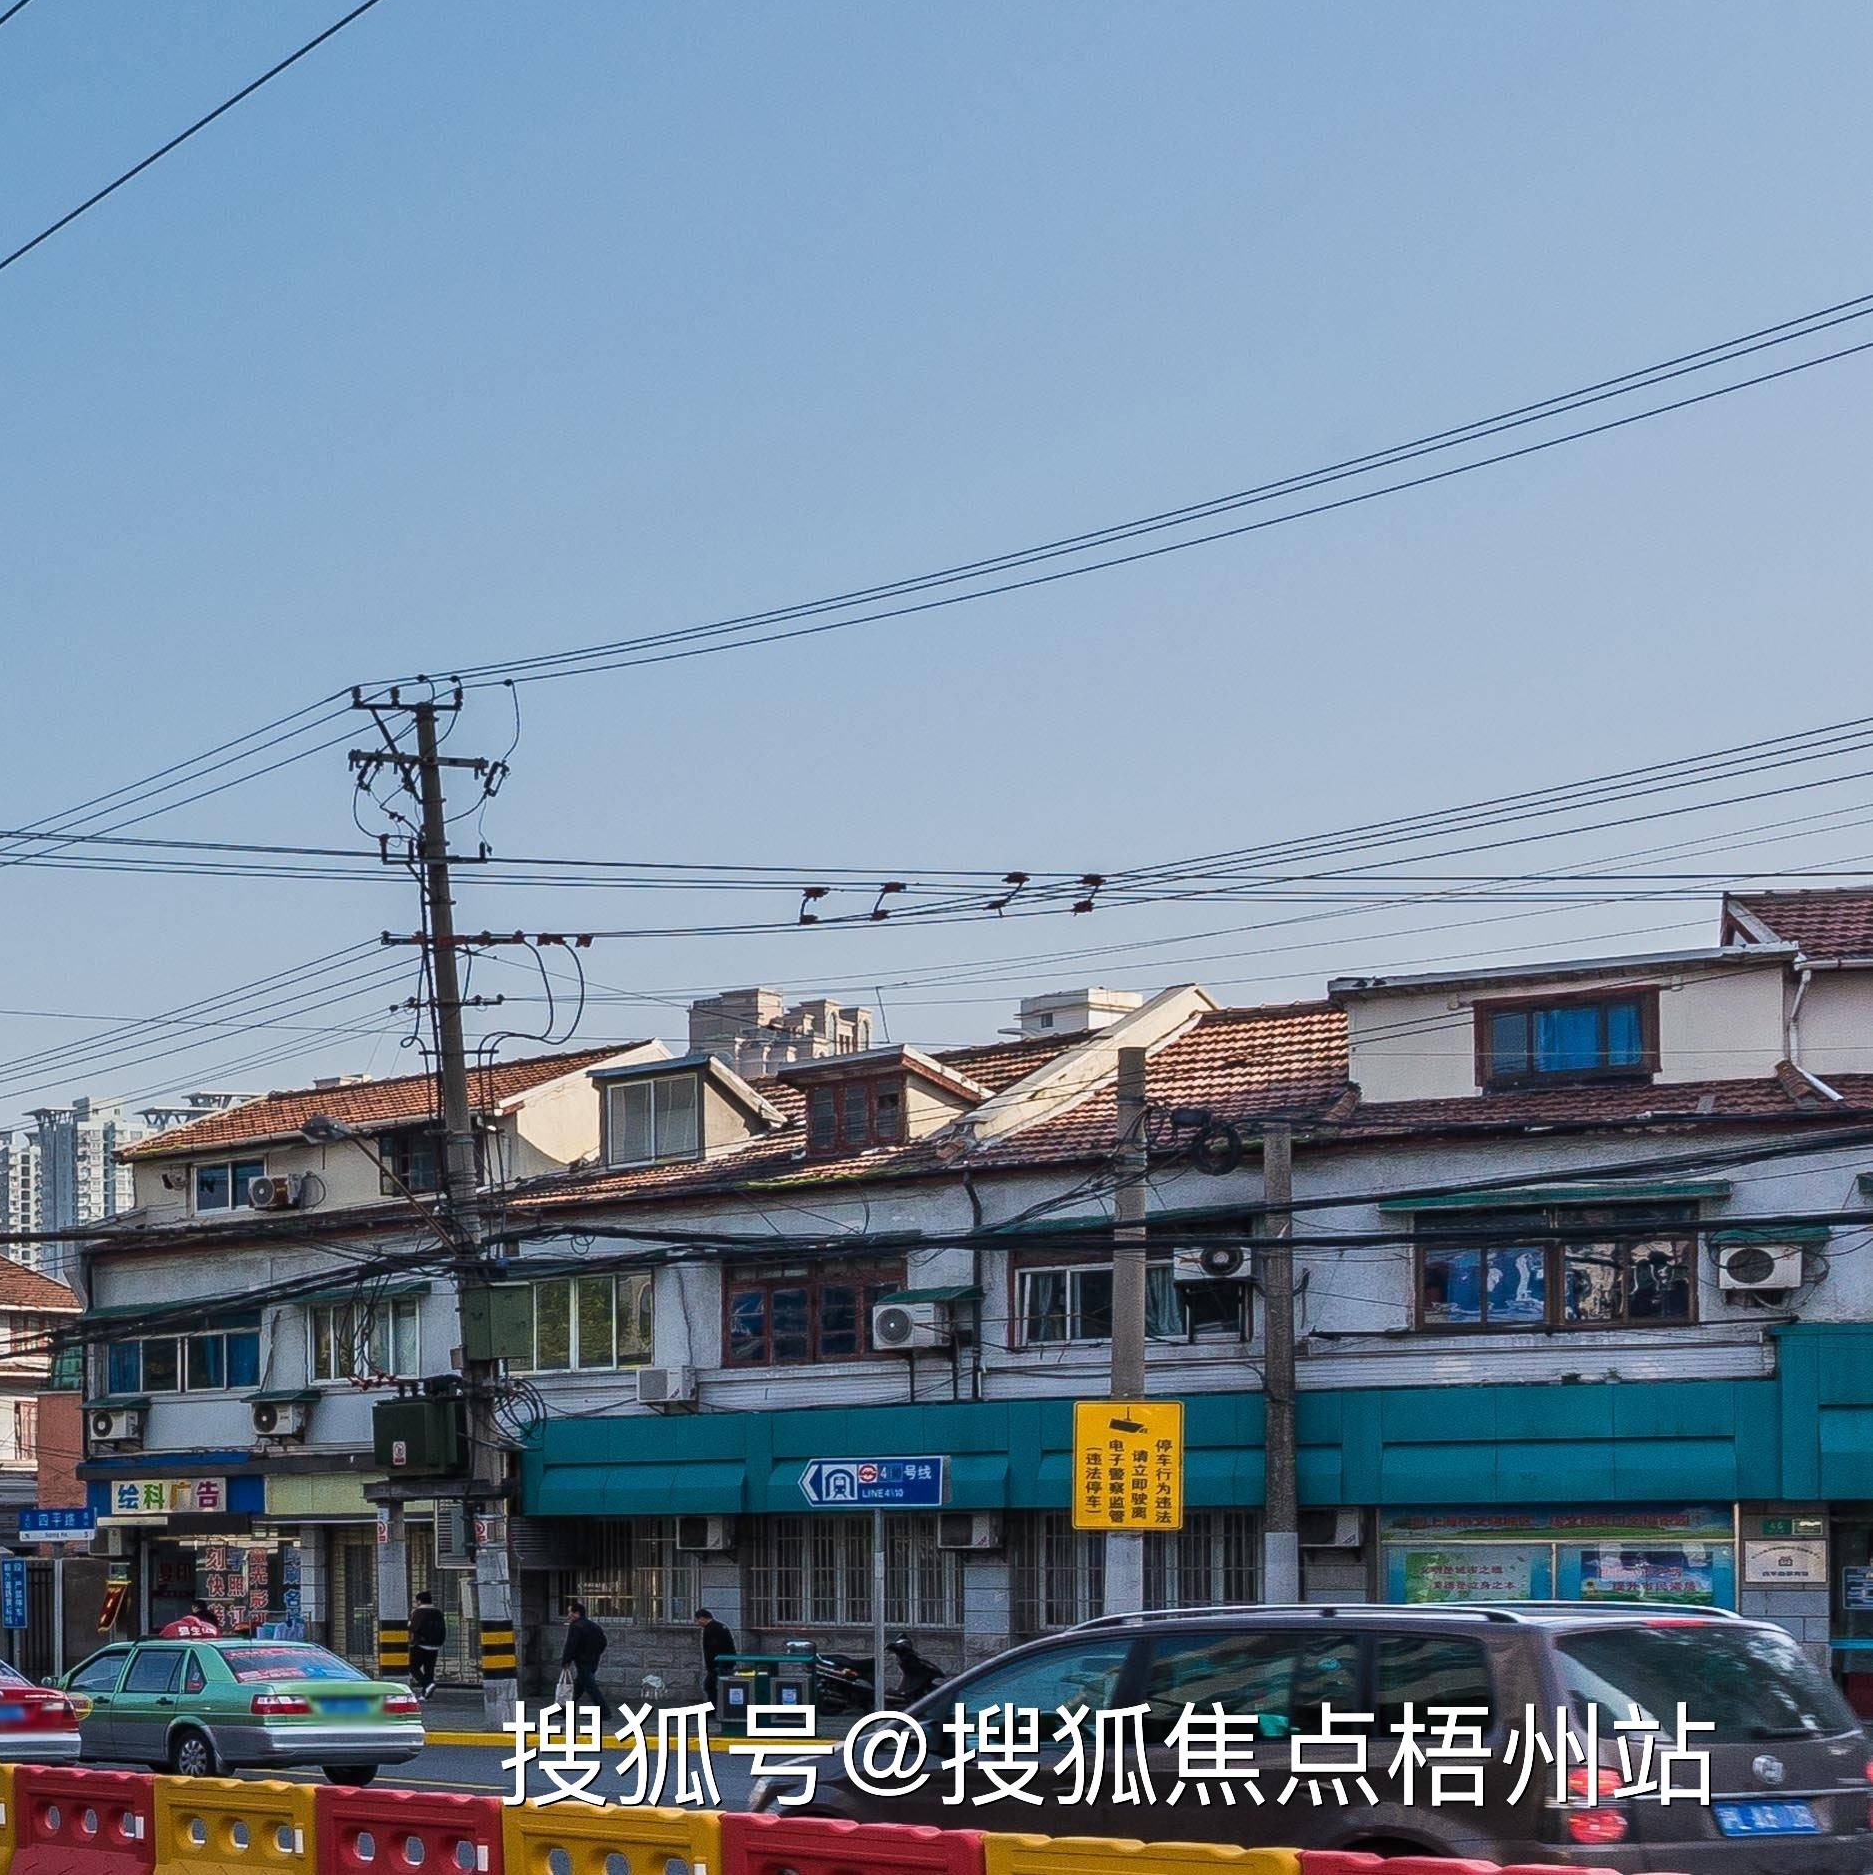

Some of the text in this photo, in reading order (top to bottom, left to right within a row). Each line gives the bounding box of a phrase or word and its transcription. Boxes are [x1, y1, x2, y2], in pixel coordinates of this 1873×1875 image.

[117, 1481, 220, 1510] 绘科广告
[1108, 1438, 1126, 1523] 电子警察监管
[1131, 1449, 1149, 1520] 请立即驶离
[1155, 1438, 1173, 1524] 停车行为违法
[38, 1512, 75, 1527] 四平路
